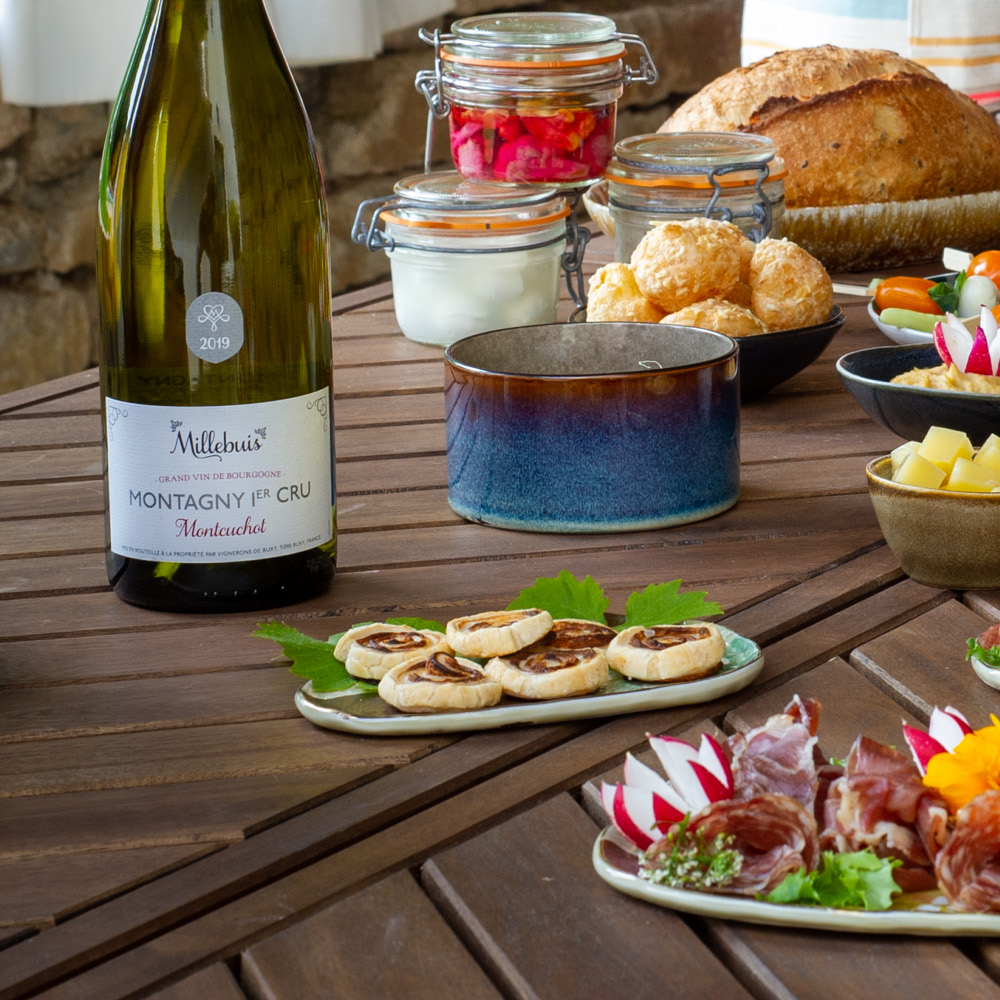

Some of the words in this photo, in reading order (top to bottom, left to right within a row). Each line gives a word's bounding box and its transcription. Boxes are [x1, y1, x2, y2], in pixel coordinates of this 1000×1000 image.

[200, 336, 230, 350] 2019
[170, 430, 263, 462] Millebuis
[158, 474, 190, 483] GRAND
[192, 473, 210, 481] VIN
[226, 470, 282, 480] BOURGOGNE
[129, 489, 245, 510] MONTAGNY
[276, 481, 311, 503] CRU
[175, 516, 267, 537] Montcuchot
[217, 549, 252, 557] VIGNERONS
